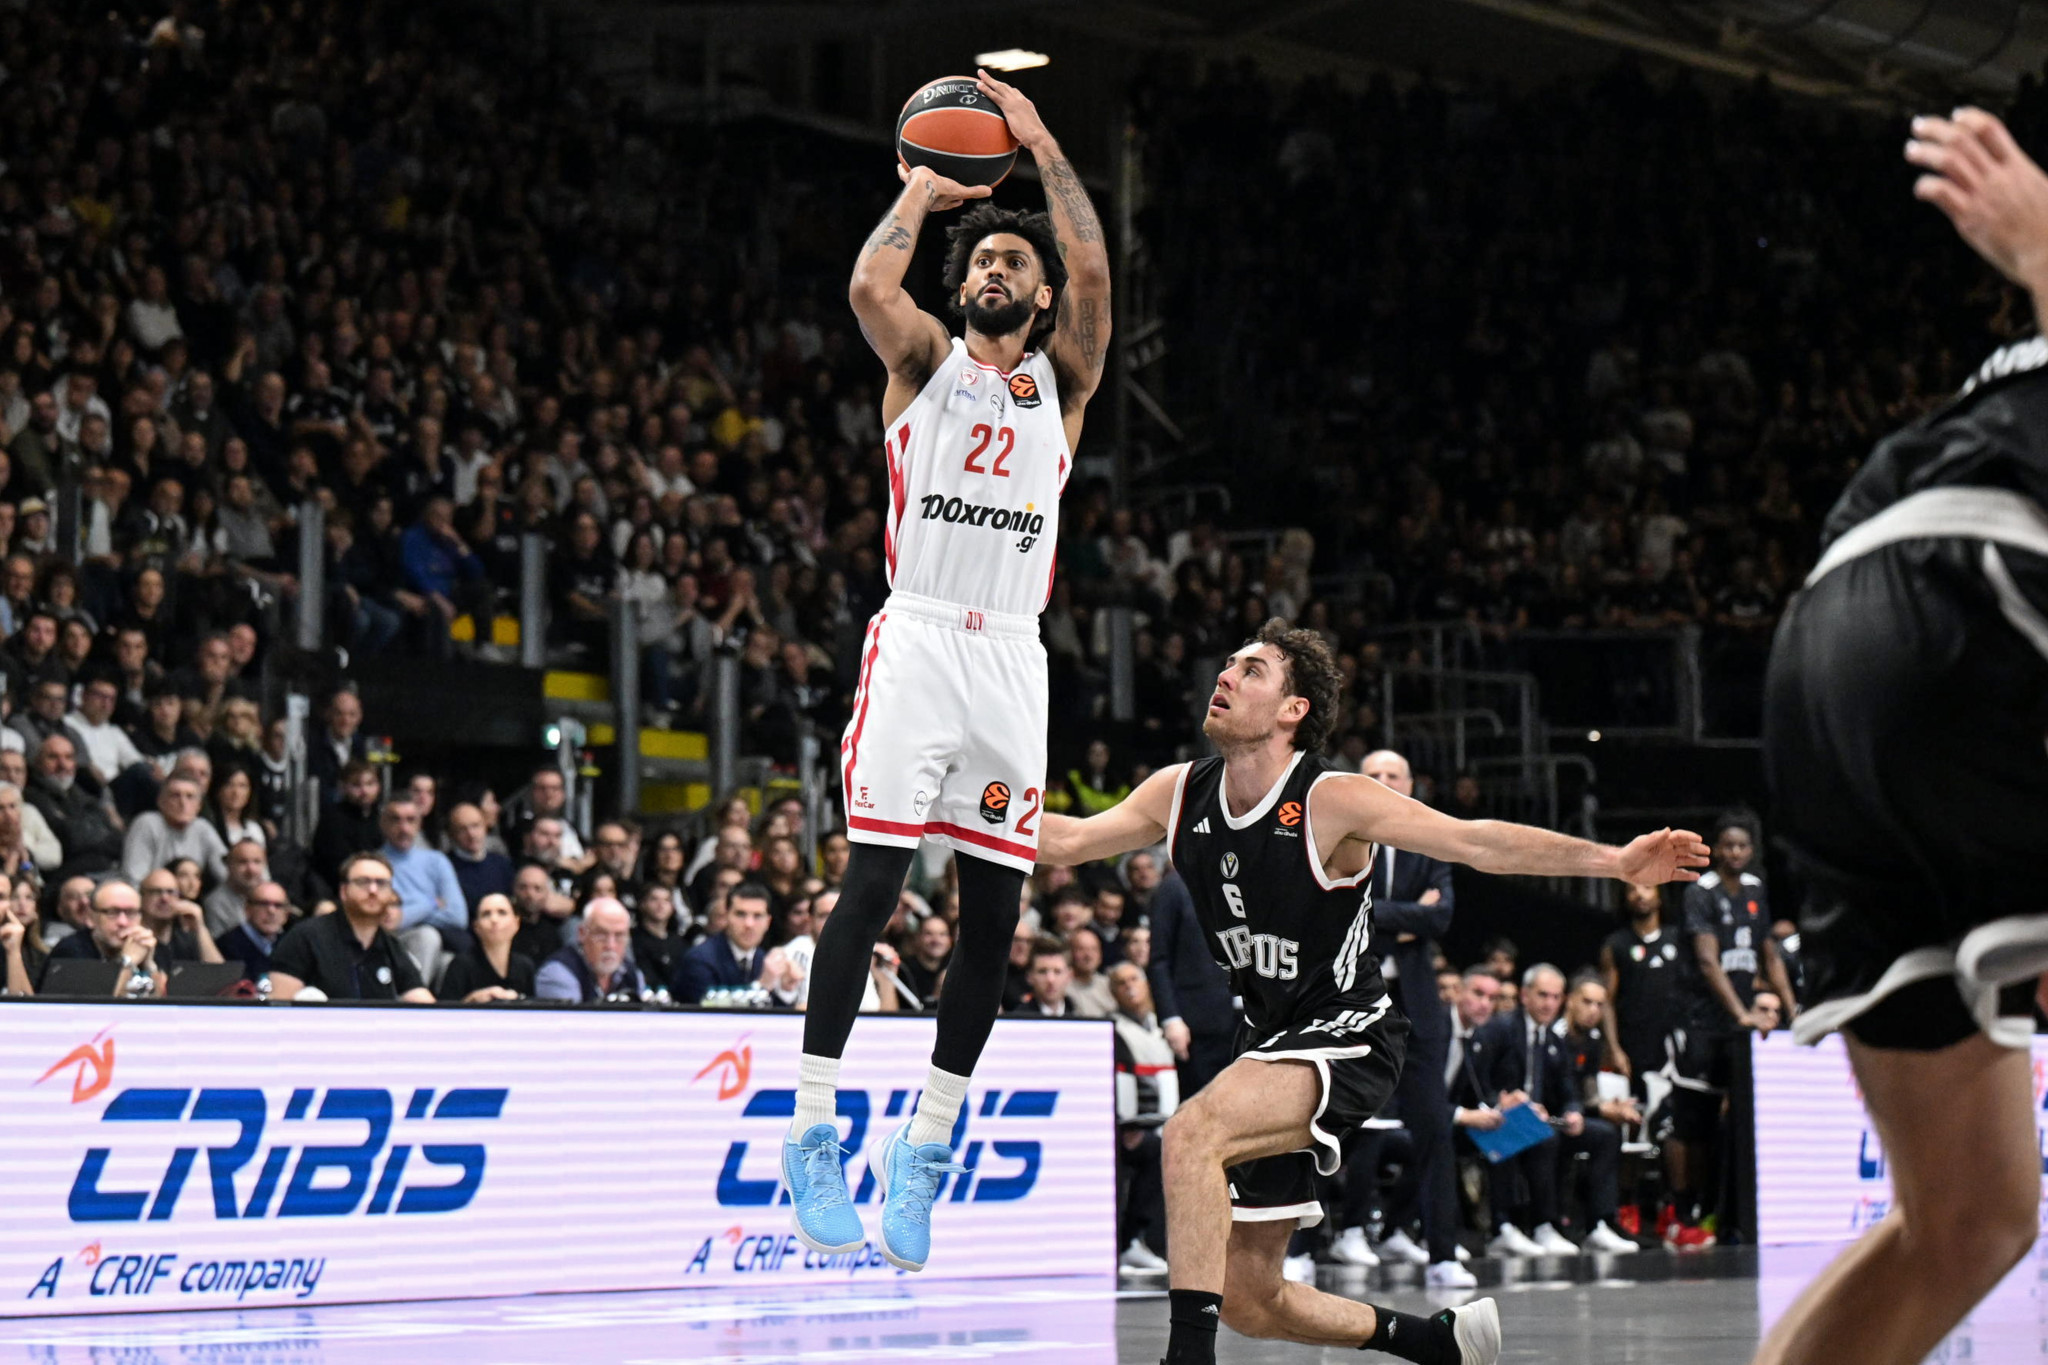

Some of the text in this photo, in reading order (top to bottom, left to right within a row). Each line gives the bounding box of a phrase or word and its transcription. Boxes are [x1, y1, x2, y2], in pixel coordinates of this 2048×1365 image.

[963, 423, 1015, 478] 22
[920, 493, 1045, 536] 100xronia
[1014, 787, 1046, 837] 2
[1222, 883, 1246, 919] 6
[67, 1087, 509, 1222] CRIBIS
[684, 1235, 713, 1273] A
[733, 1234, 799, 1272] CRIF
[27, 1254, 326, 1301] A CRIF company
